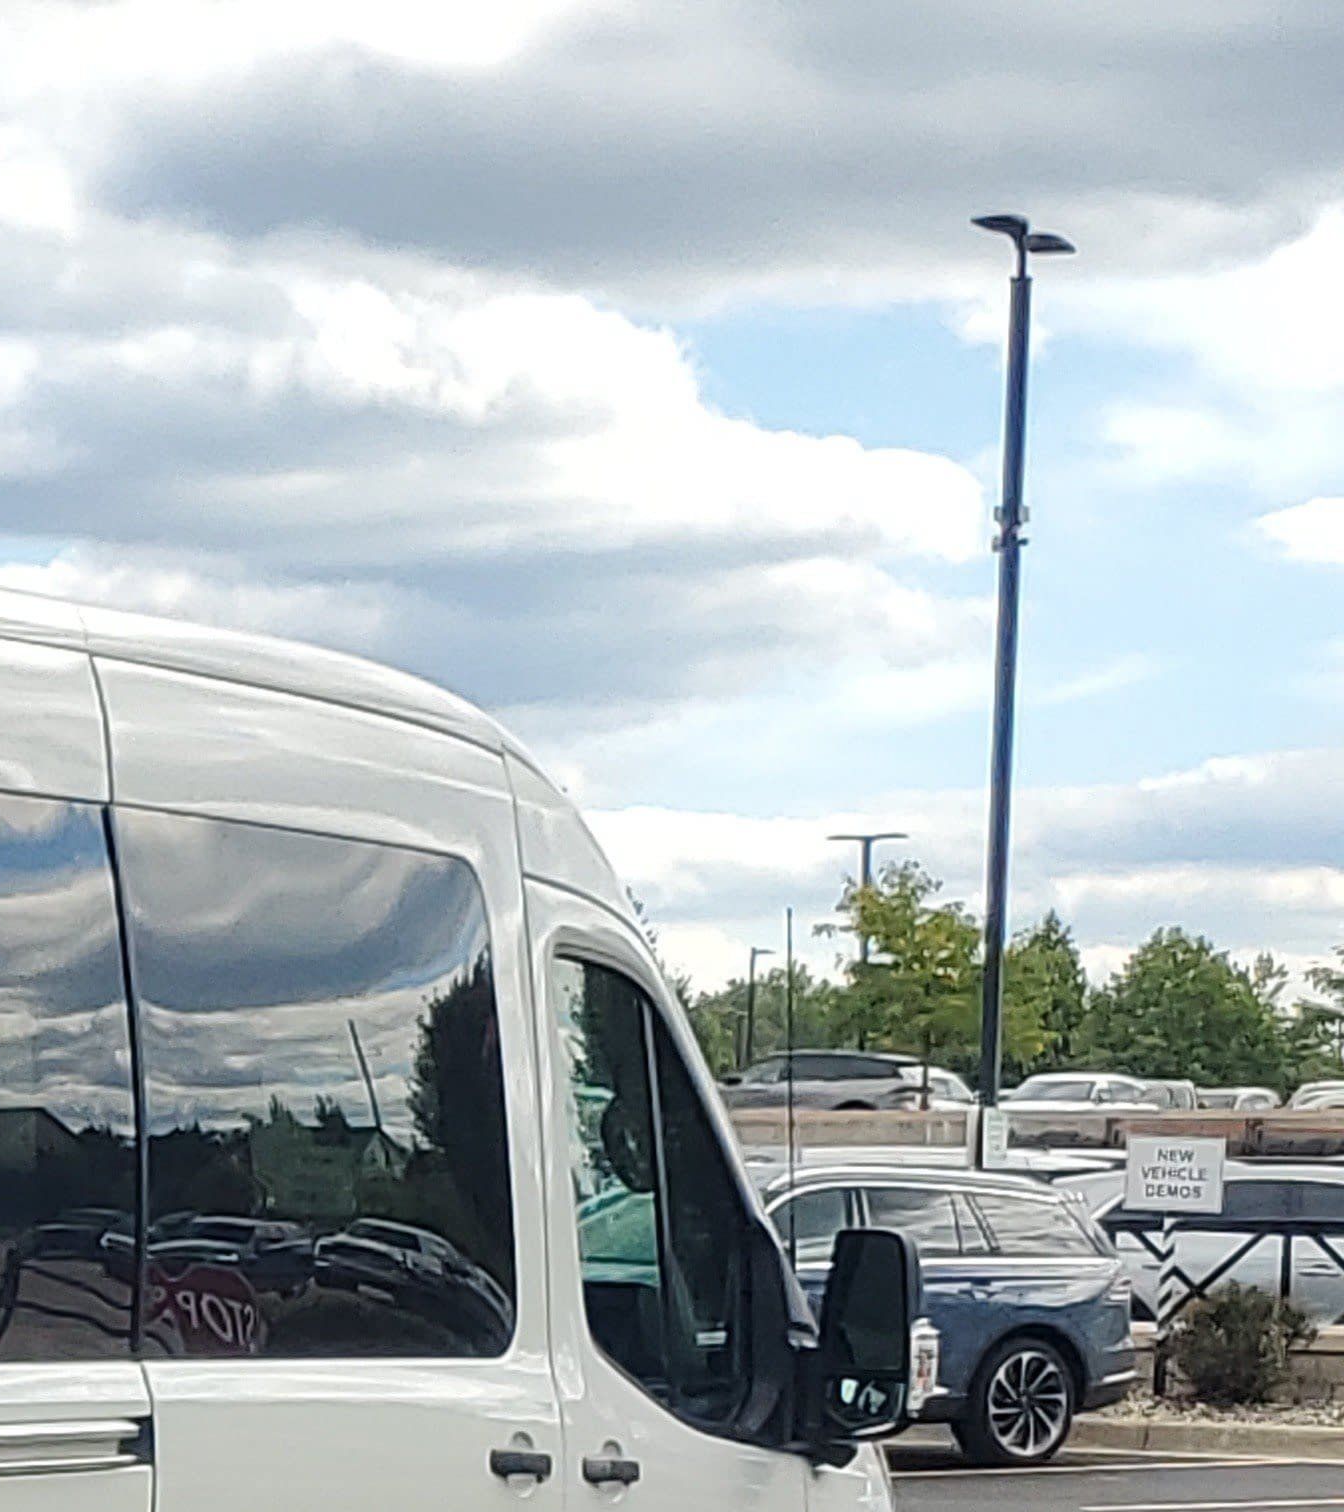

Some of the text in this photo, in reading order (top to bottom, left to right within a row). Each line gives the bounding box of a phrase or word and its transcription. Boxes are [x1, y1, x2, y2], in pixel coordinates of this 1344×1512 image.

[1157, 1148, 1195, 1162] NEW
[1141, 1165, 1208, 1181] VEHICLE
[1145, 1183, 1202, 1199] DEMOS
